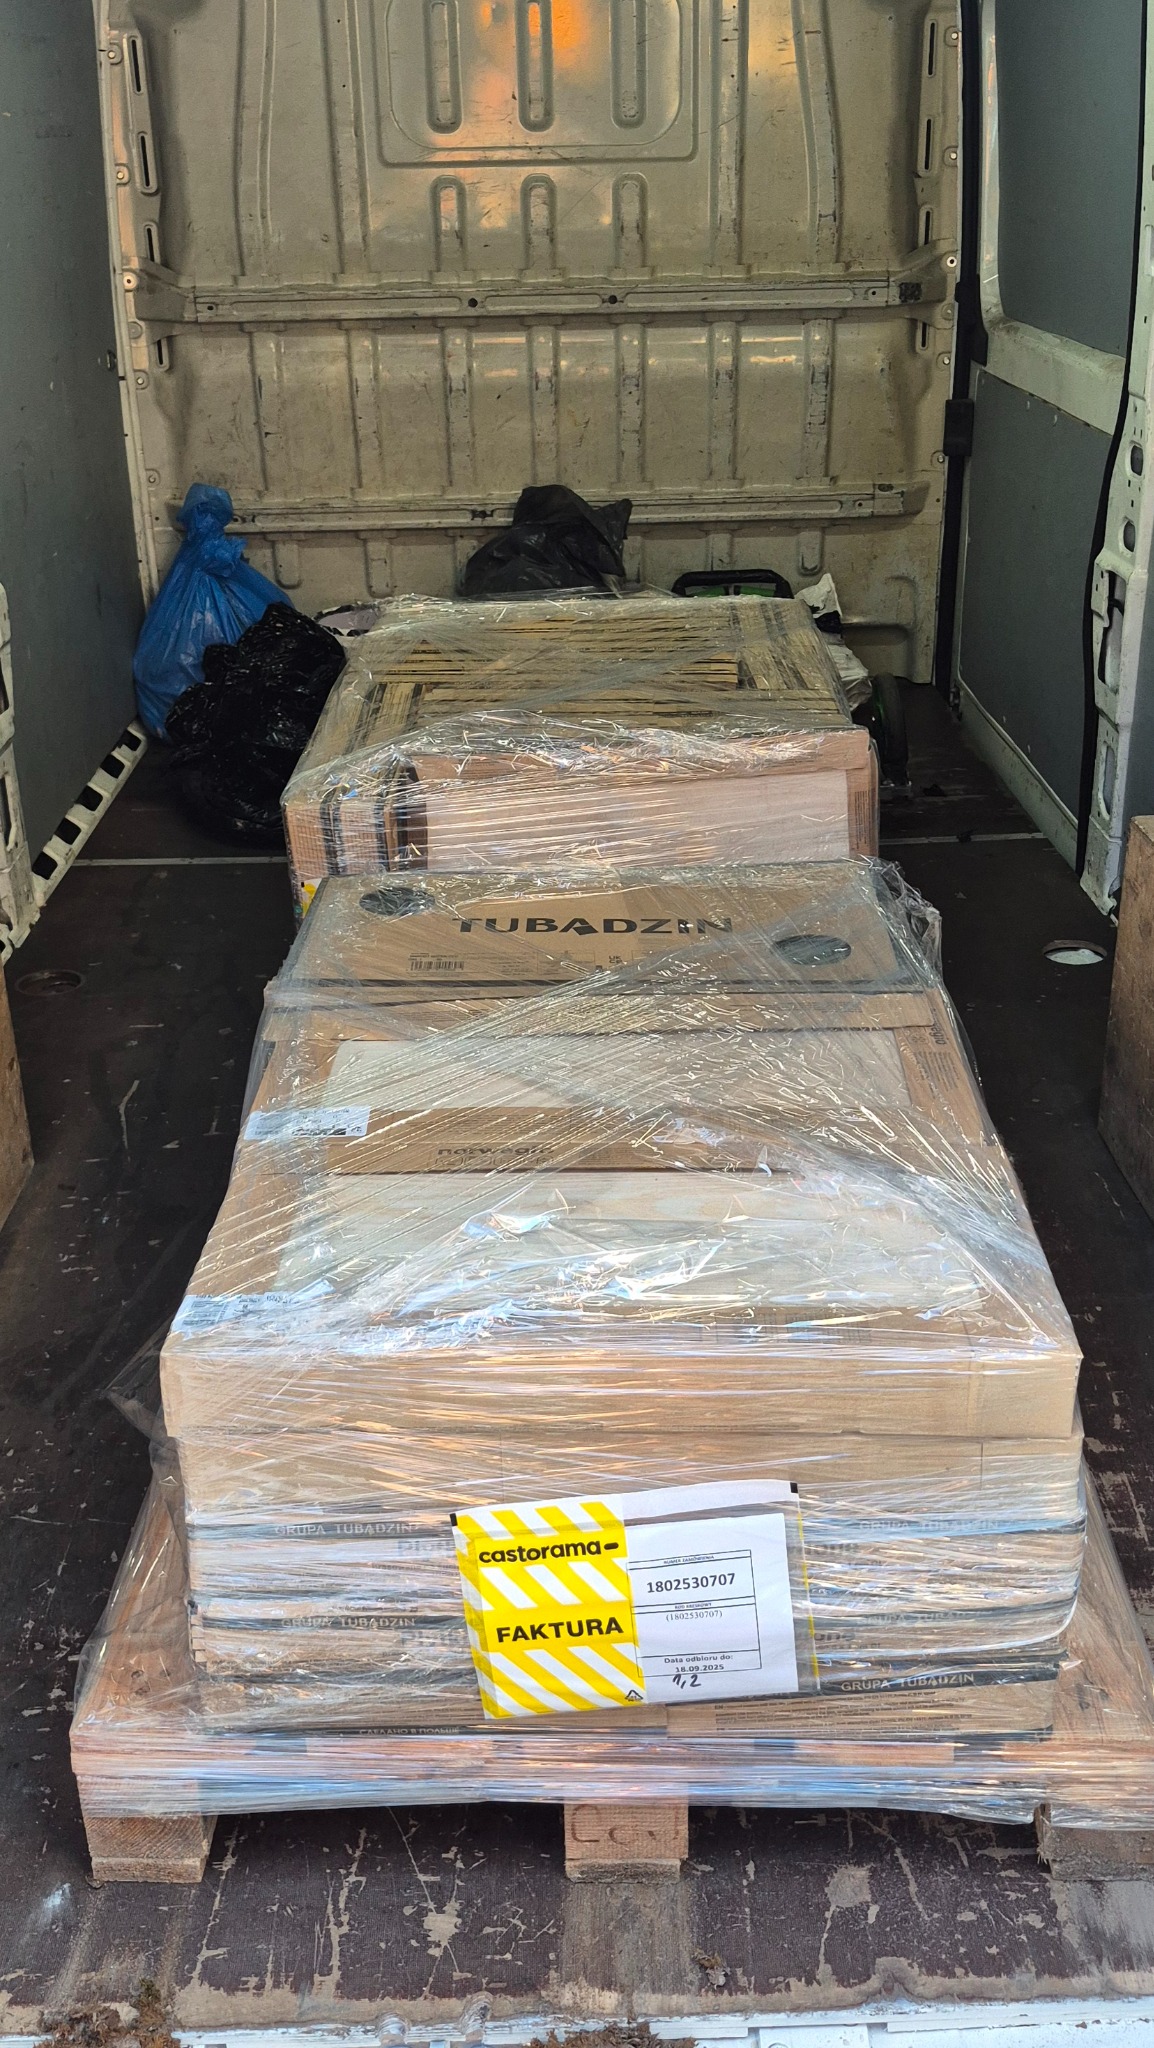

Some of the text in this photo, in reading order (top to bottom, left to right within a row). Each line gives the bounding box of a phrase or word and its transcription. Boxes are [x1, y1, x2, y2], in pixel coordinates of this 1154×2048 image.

[452, 917, 733, 936] TUBADZIN
[274, 1522, 413, 1536] GRUPA TUBADZIN
[478, 1540, 602, 1564] castorama
[646, 1572, 736, 1593] 1802530707
[665, 1610, 723, 1622] (1802530707)
[496, 1616, 624, 1643] FAKTURA
[675, 1664, 724, 1673] 18.09.2025
[685, 1655, 718, 1663] odbioru
[841, 1673, 974, 1692] GRUPA TUBADZIN
